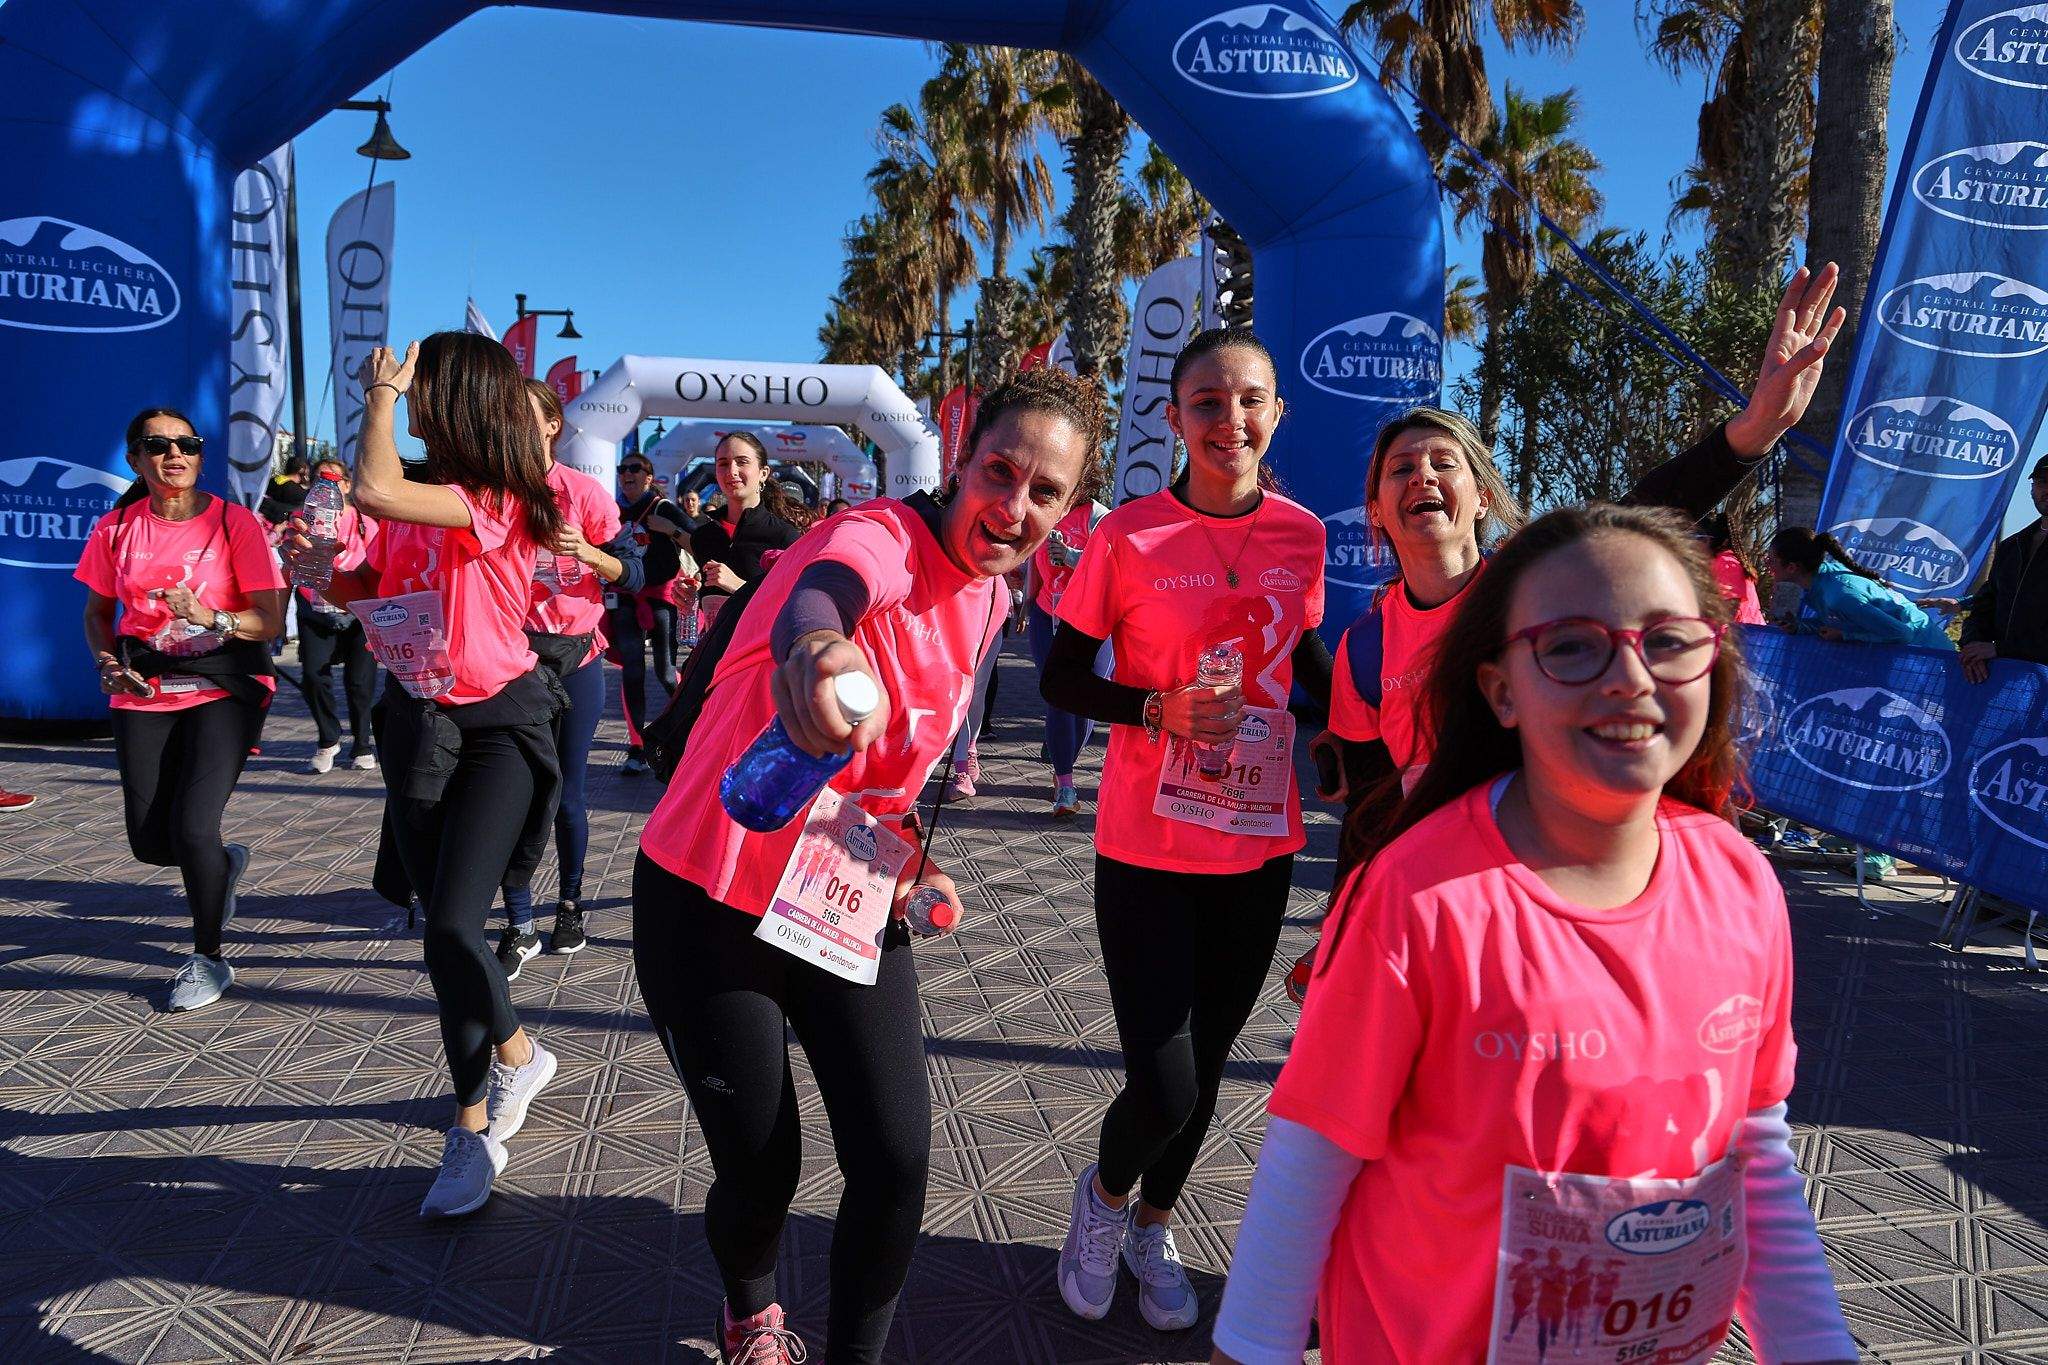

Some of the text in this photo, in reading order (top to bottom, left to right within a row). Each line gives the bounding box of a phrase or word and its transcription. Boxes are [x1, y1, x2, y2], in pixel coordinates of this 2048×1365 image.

[1221, 33, 1284, 46] CENTRAL
[1187, 36, 1351, 79] ASTURIANA
[1964, 166, 2029, 181] CENTRAL
[5, 253, 156, 283] NTRAL LECHERA
[0, 269, 163, 316] TURIANA
[1923, 294, 1986, 310] CENTRAL
[1343, 342, 1401, 352] CENTRAL
[1313, 344, 1440, 381] ASTURIAN
[674, 370, 828, 407] OYSHO
[1123, 296, 1184, 498] OYSHO
[579, 402, 628, 414] OYSHO
[870, 410, 916, 423] OYSHO
[1854, 416, 2005, 468] ASTURIANA
[1886, 417, 2007, 444] CENTRAL LECHERA
[894, 473, 936, 486] OYSHO
[1, 493, 115, 511] NTRAL LECH
[1154, 573, 1215, 591] OYSHO
[1792, 709, 1932, 779] ASTURIANA
[1176, 788, 1206, 801] CARRERA
[1207, 794, 1217, 804] DE
[1217, 797, 1226, 806] LA
[1220, 785, 1246, 800] 7696
[1171, 802, 1215, 819] OYSHO
[1239, 818, 1273, 829] Santander
[825, 876, 863, 913] 016
[821, 908, 841, 926] 5163
[777, 924, 811, 949] OYSHO
[826, 950, 860, 972] Santander
[1473, 1029, 1607, 1062] OYSHO
[1528, 1221, 1591, 1244] SUMA
[1614, 1215, 1705, 1245] ASTURIANA
[1603, 1283, 1695, 1336] 016
[1615, 1338, 1659, 1363] 5162
